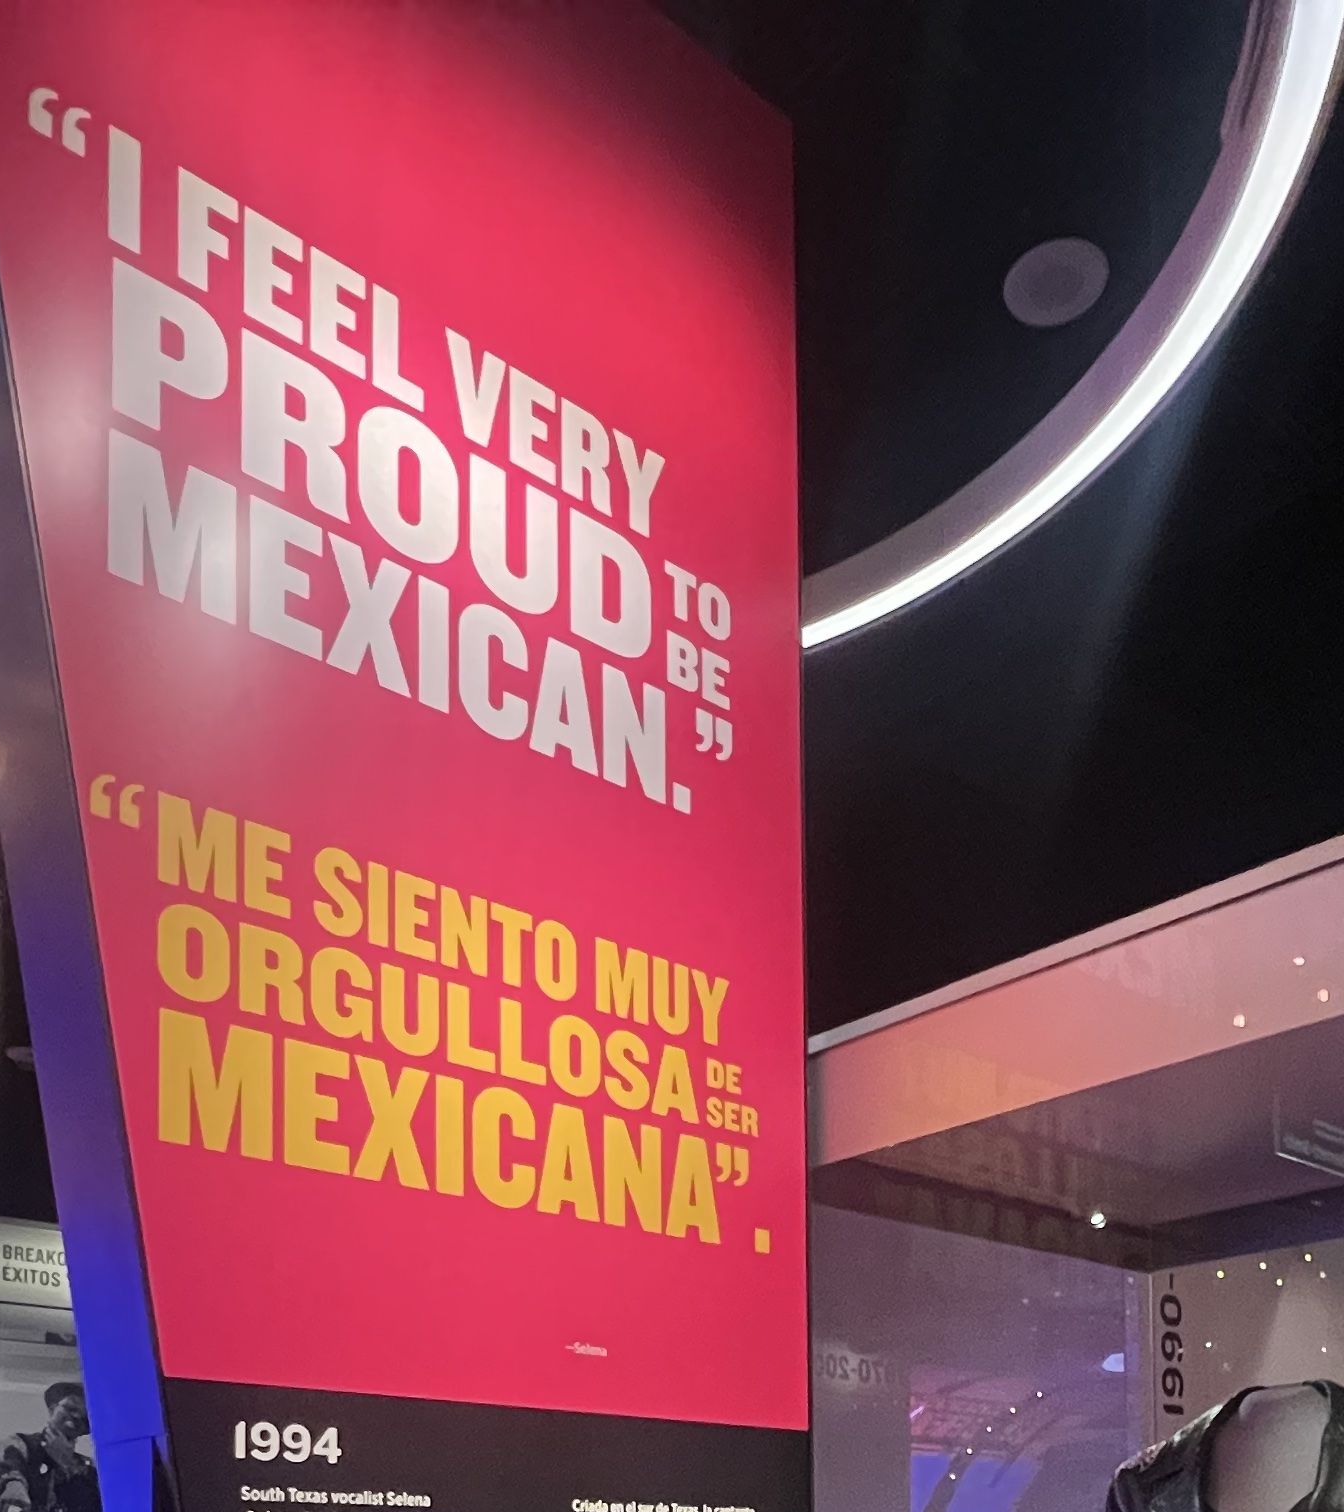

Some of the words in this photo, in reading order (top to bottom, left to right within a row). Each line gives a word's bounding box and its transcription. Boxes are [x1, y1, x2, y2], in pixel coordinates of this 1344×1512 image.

[178, 166, 423, 413] FEEL
[446, 327, 666, 537] VERY
[112, 256, 651, 659] PROUD
[665, 561, 731, 641] TO
[668, 644, 731, 711] BE
[313, 847, 577, 1002] SIENTO
[595, 937, 729, 1046] MUY
[157, 904, 700, 1125] ORGULLOSA
[706, 1057, 742, 1094] DE
[706, 1096, 760, 1137] SER
[2, 1244, 66, 1267] BREAKO
[233, 1420, 342, 1464] 1994
[240, 1485, 284, 1502] South
[288, 1486, 328, 1504] Texas
[330, 1490, 384, 1505] vocalist
[386, 1490, 430, 1507] Selena
